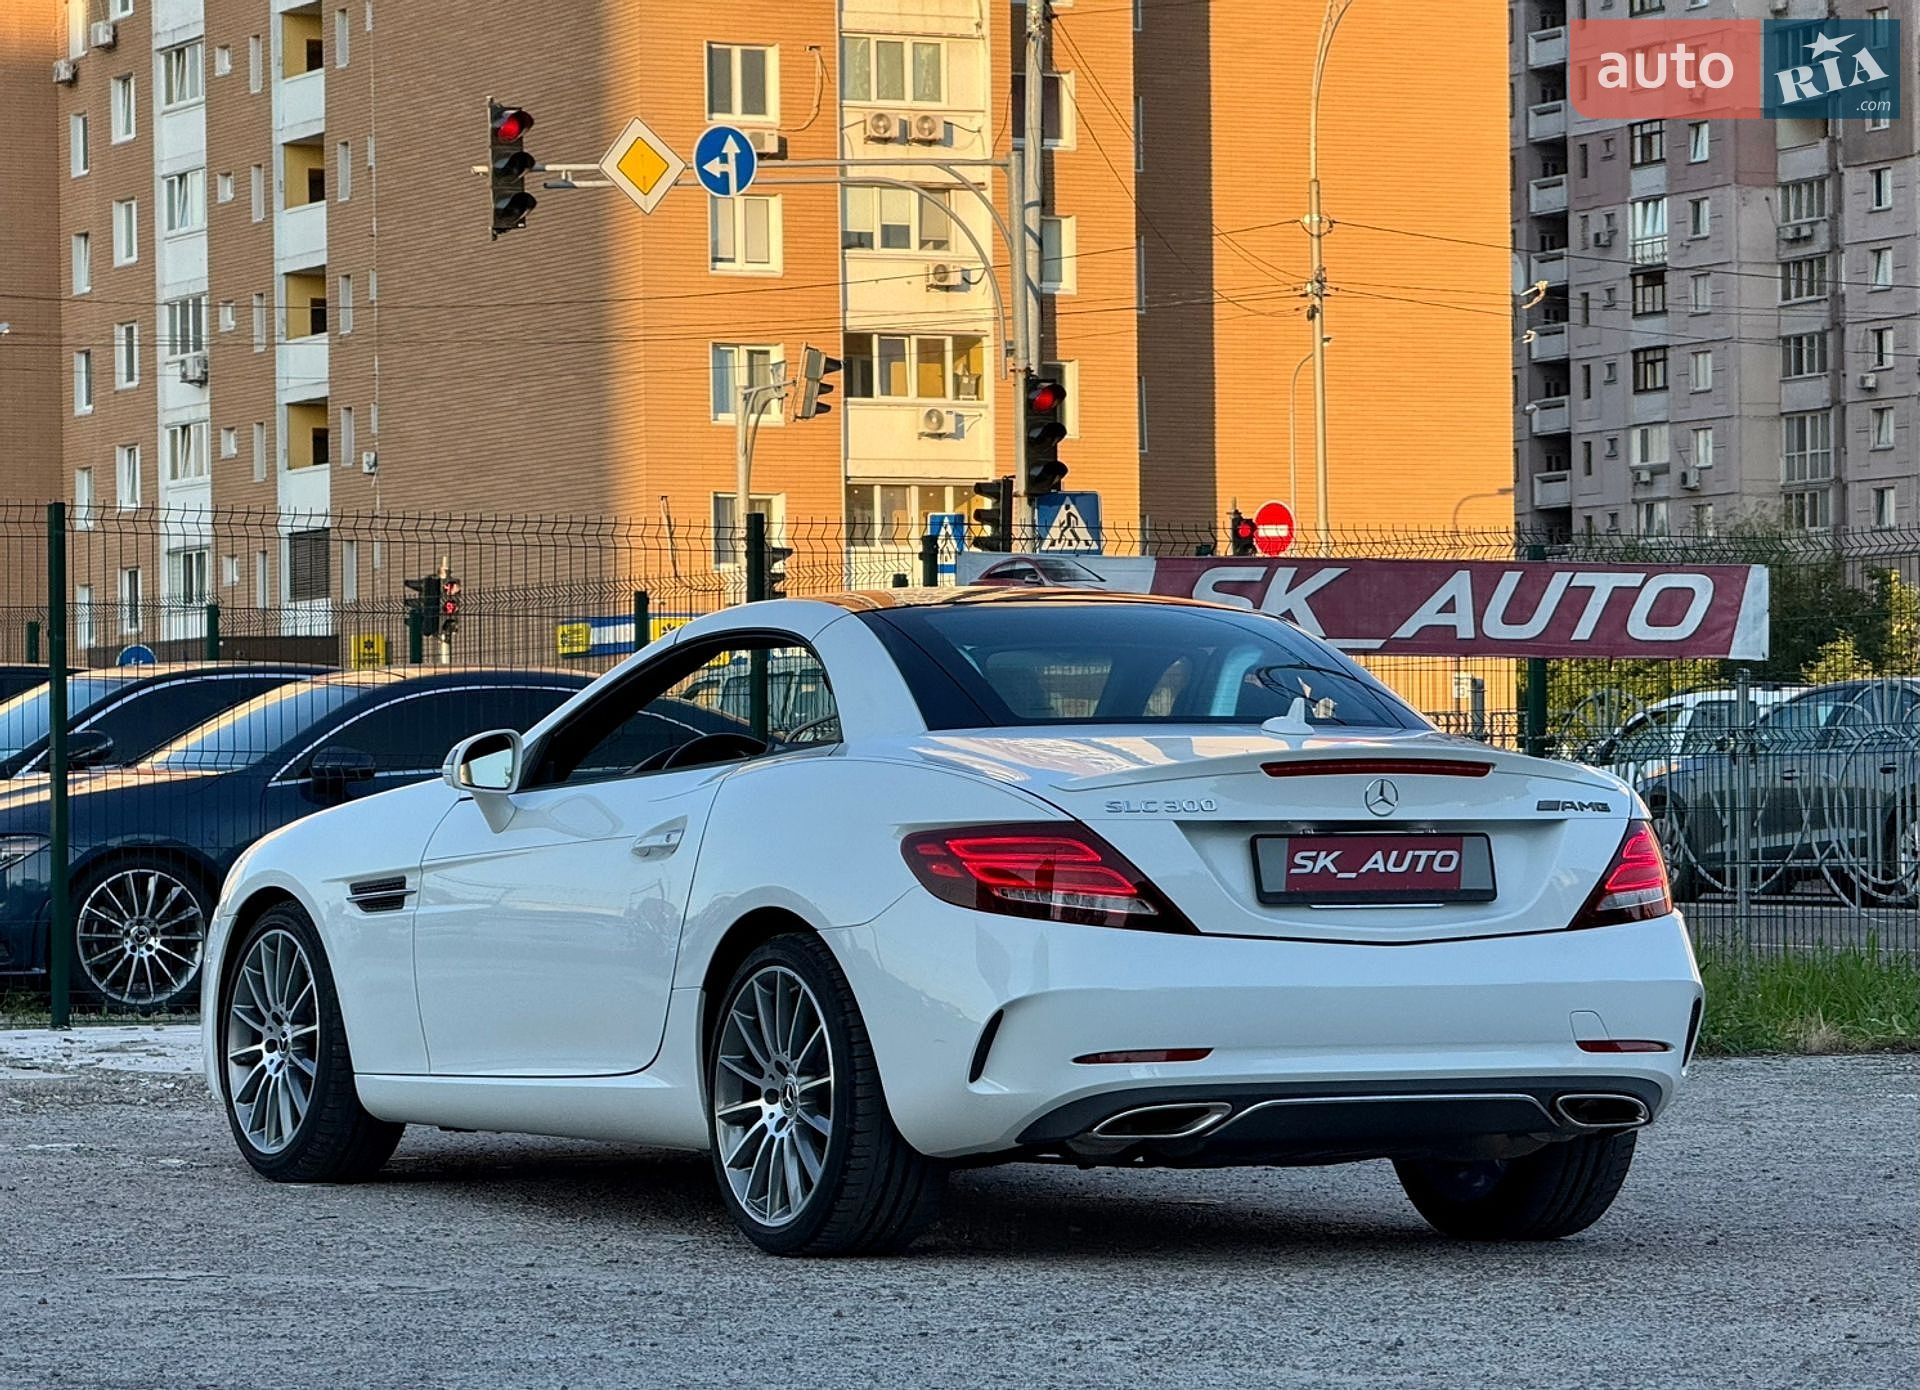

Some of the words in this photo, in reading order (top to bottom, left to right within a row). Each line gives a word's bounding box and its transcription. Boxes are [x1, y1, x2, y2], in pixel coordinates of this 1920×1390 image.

[1105, 799, 1158, 814] SLC
[1164, 799, 1217, 813] 300
[1561, 800, 1611, 812] AMG
[1289, 850, 1460, 879] SK_AUTO
